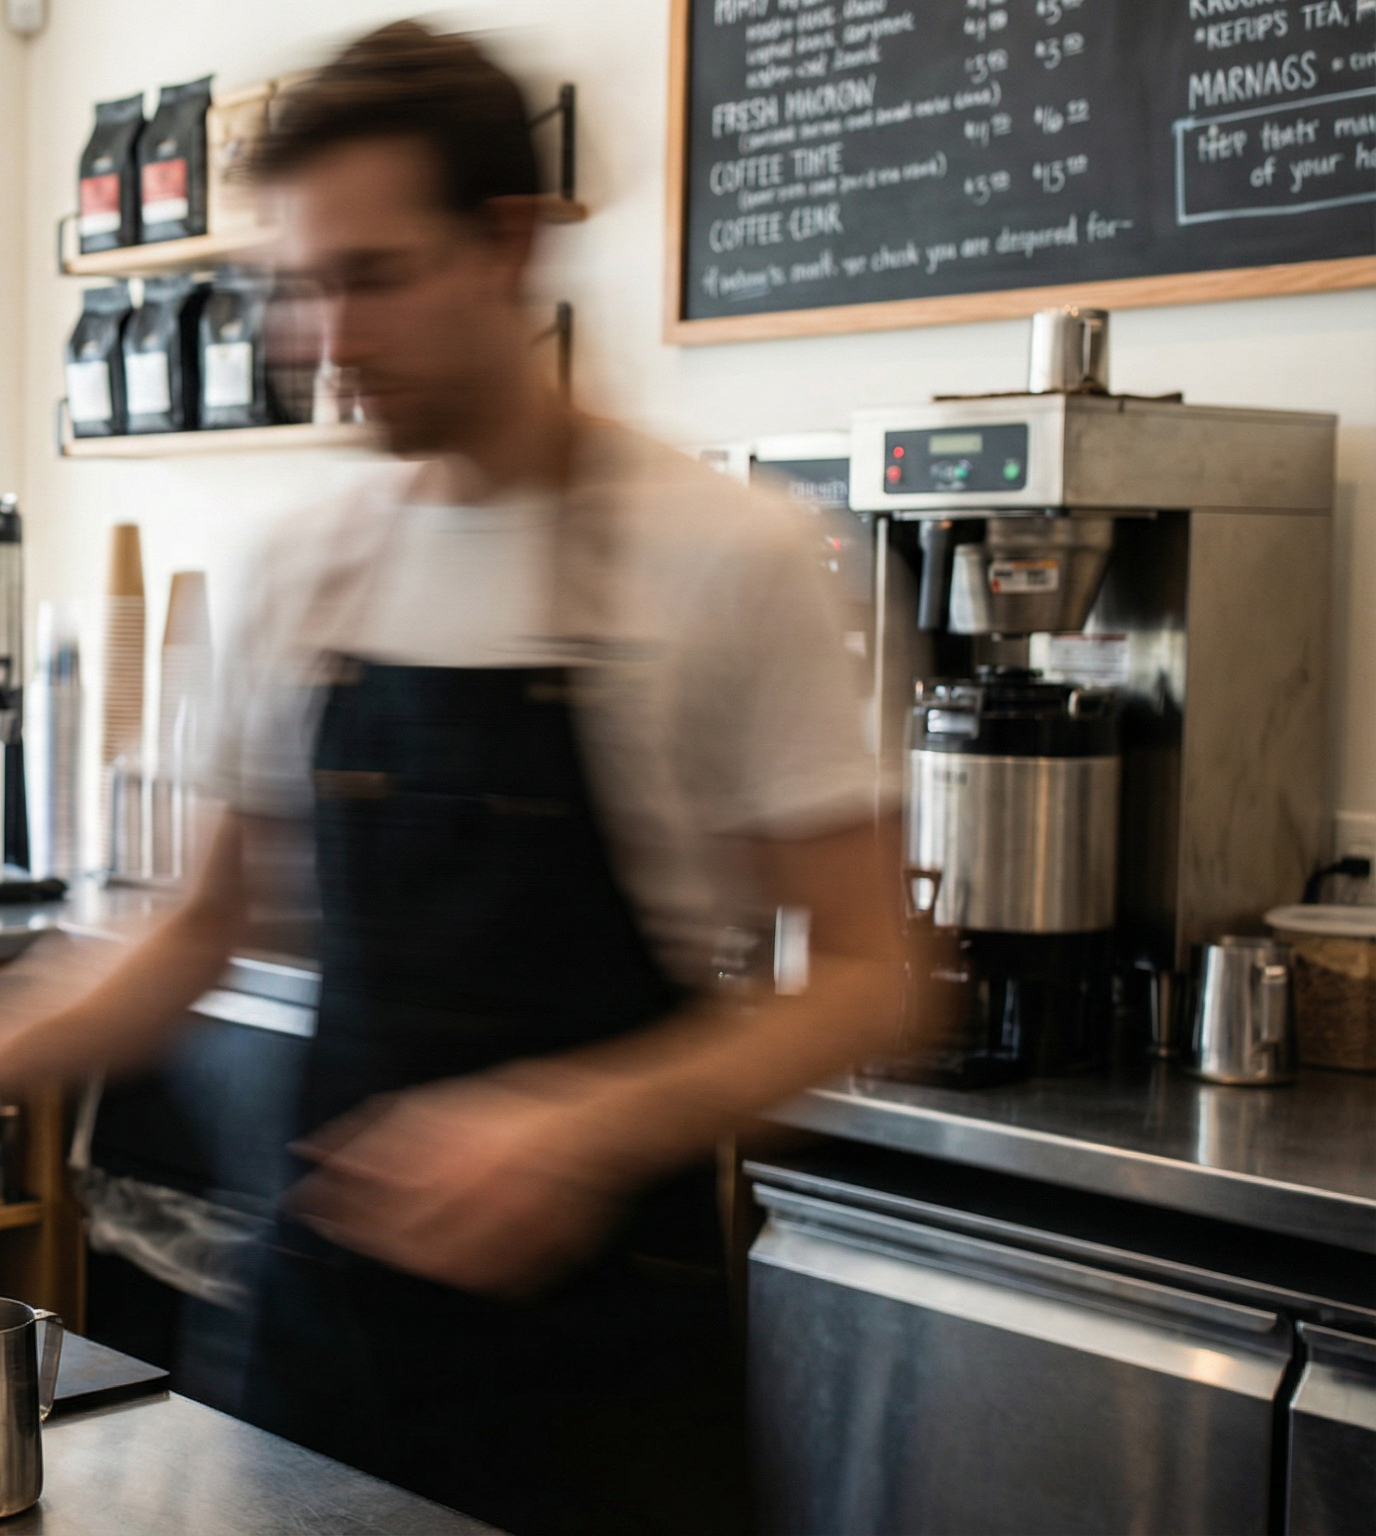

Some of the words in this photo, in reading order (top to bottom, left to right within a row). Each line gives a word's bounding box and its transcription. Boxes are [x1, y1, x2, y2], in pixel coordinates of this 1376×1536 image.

[710, 153, 784, 195] COFFEE
[1250, 156, 1279, 188] of
[1289, 153, 1345, 193] your
